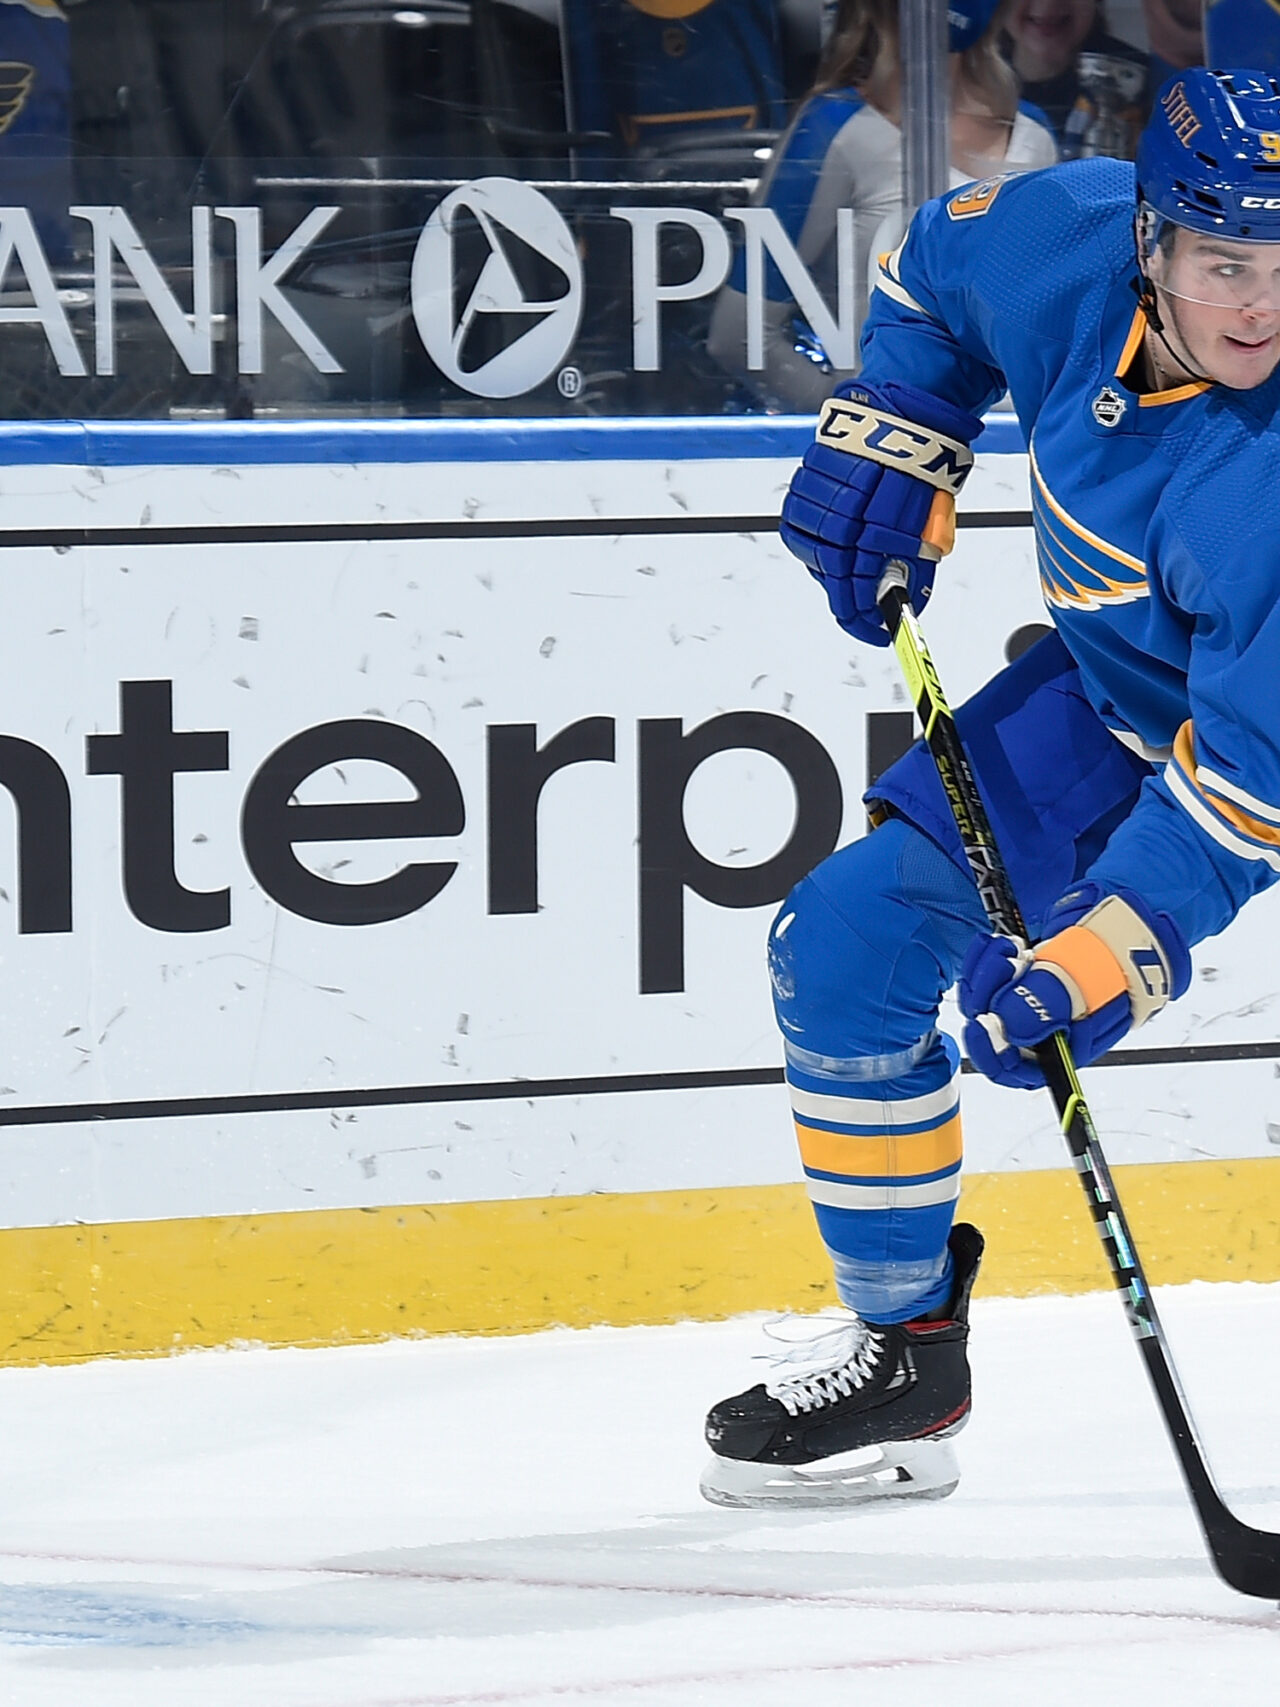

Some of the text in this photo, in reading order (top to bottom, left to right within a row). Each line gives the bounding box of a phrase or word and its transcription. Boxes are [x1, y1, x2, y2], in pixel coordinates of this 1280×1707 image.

[1160, 81, 1202, 149] STIFEL
[819, 406, 974, 490] CCM
[936, 754, 975, 836] SUPER
[1013, 985, 1052, 1022] CCM
